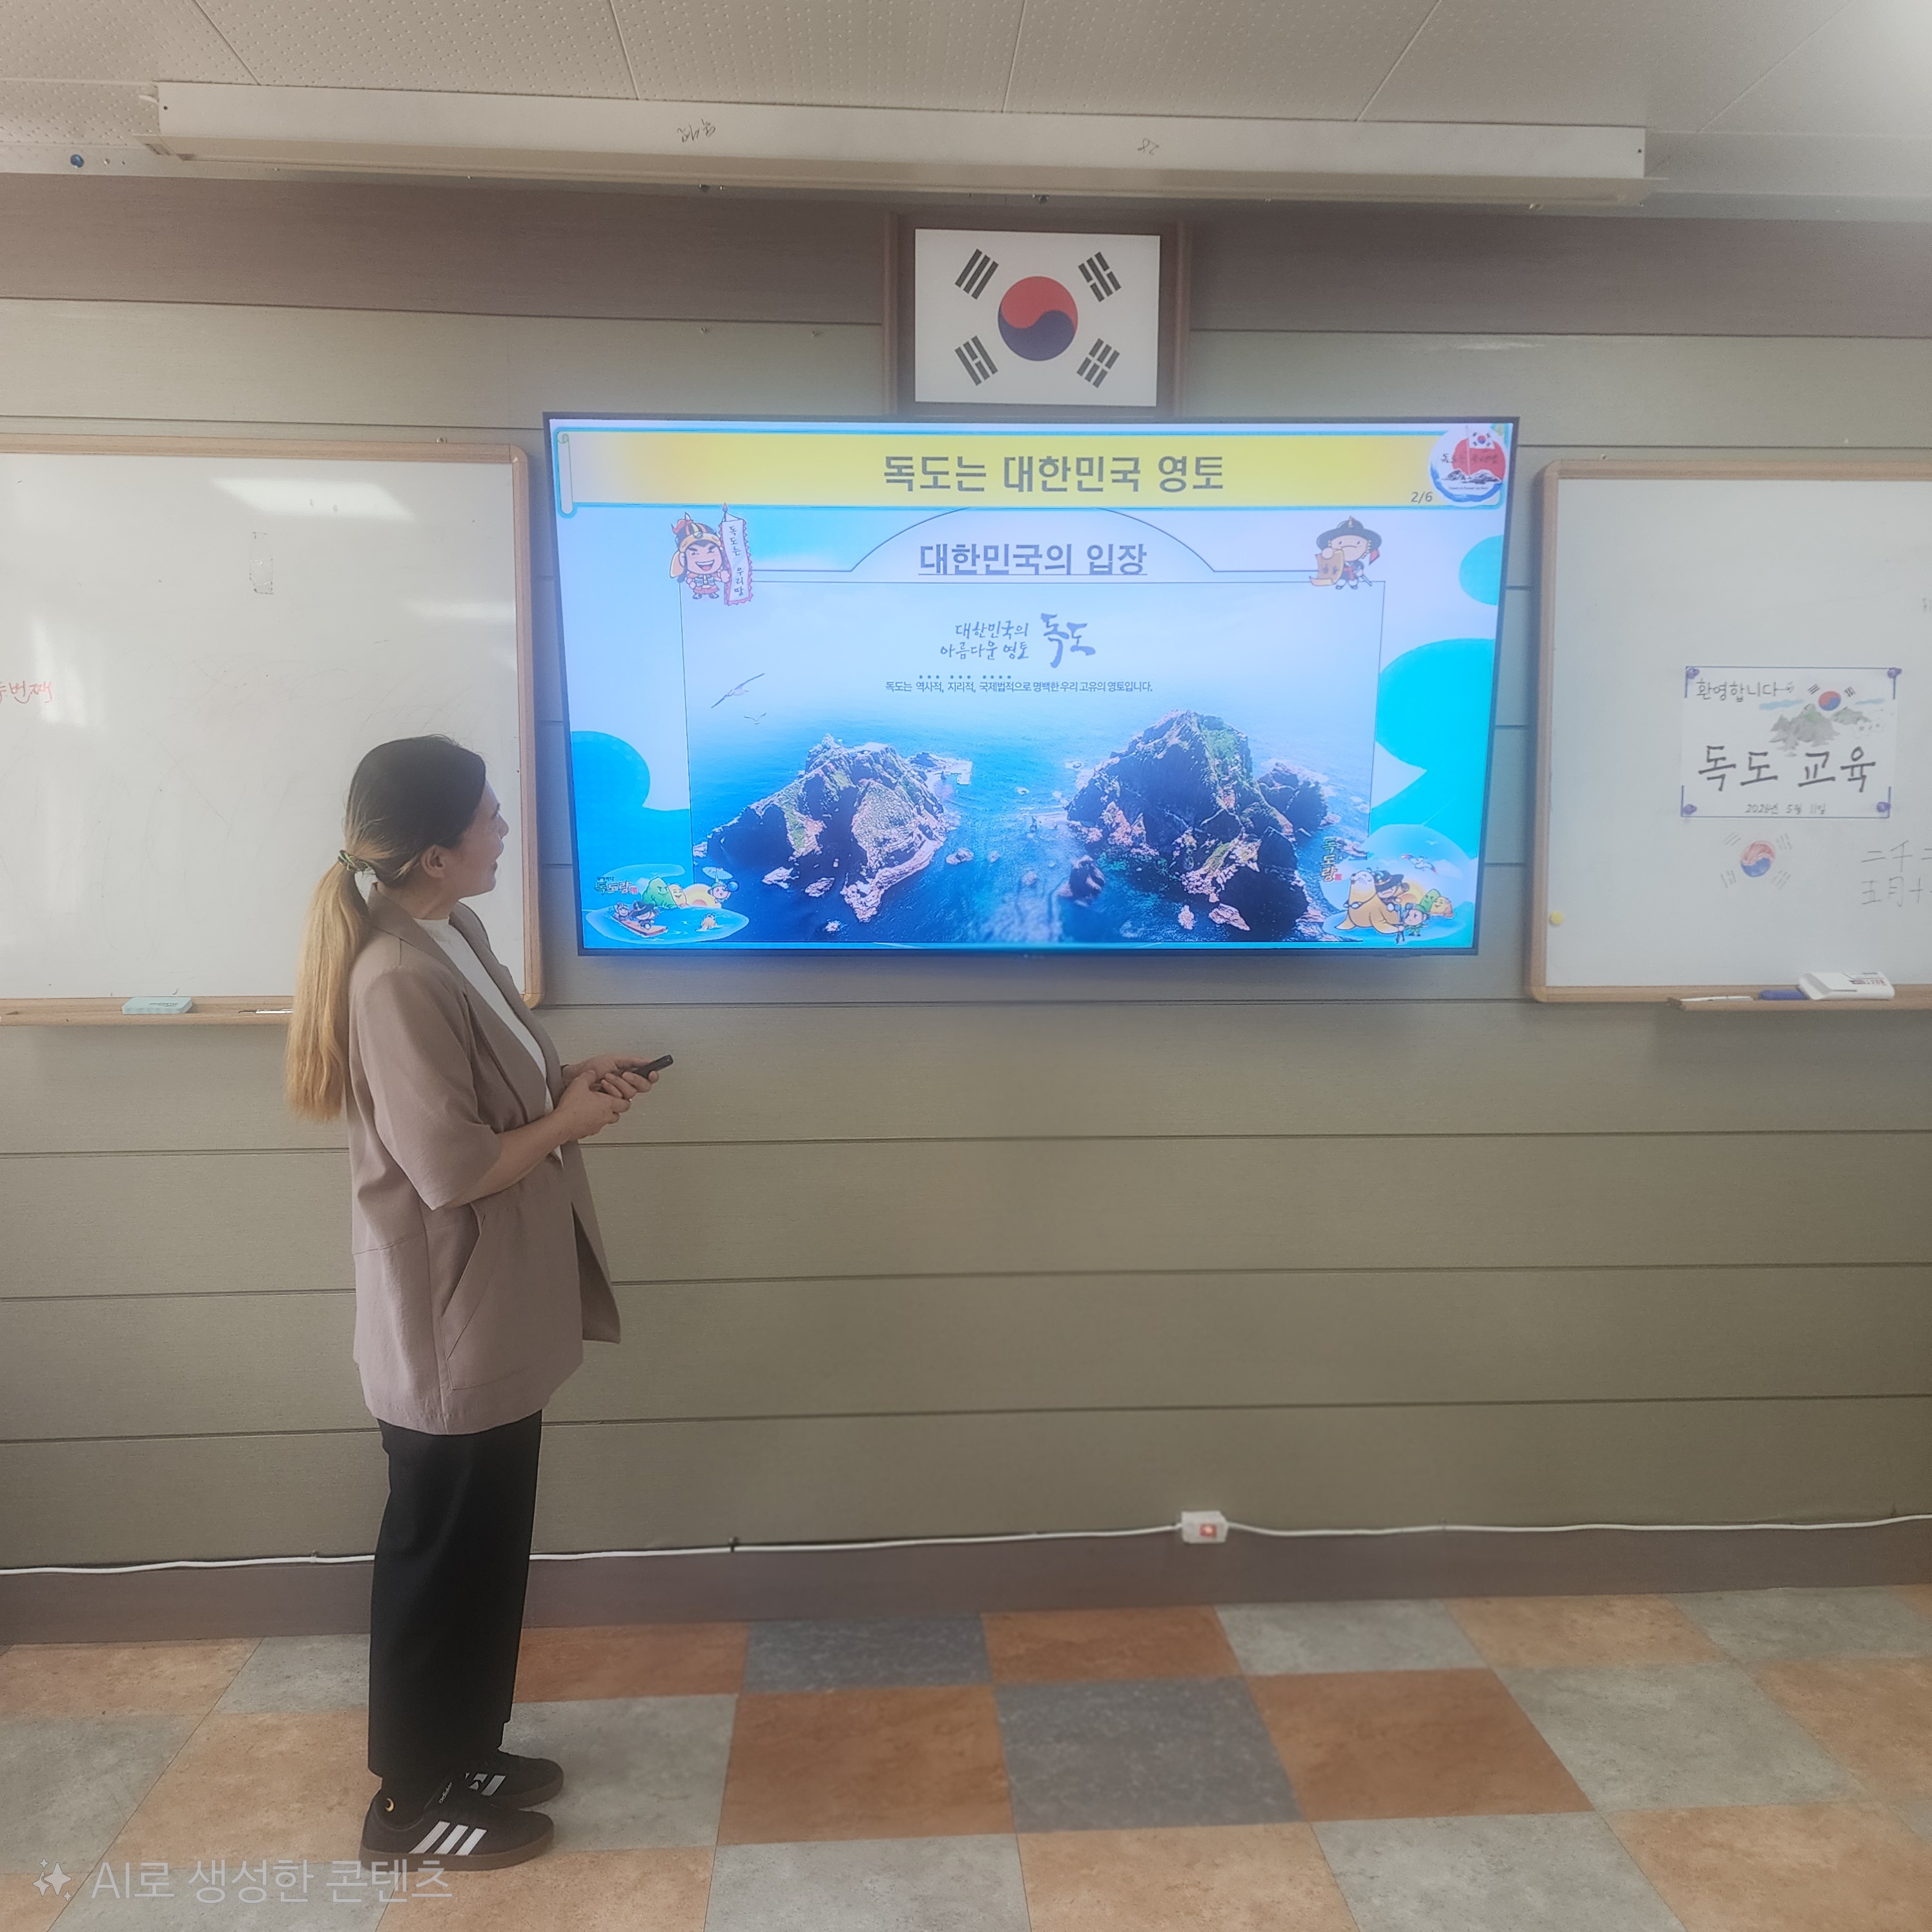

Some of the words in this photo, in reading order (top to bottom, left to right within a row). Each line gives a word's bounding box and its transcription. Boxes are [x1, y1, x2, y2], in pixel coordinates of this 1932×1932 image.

[883, 456, 987, 493] 독도는
[1003, 456, 1141, 493] 대한민국
[1158, 455, 1224, 493] 영토
[1410, 491, 1433, 504] 2/6
[728, 526, 741, 556] 독도는
[920, 543, 1072, 575] 대한민국의
[1086, 543, 1147, 575] 입장
[955, 620, 1029, 639] 대한민국의
[1040, 613, 1096, 668] 독도
[940, 640, 998, 660] 아름다운
[1003, 641, 1029, 660] 영토
[885, 681, 912, 692] 독도는
[916, 681, 944, 693] 역사적,
[947, 681, 976, 693] 지리적,
[979, 681, 1031, 692] 국제법적으로
[1033, 681, 1059, 692] 명백한
[1060, 681, 1078, 692] 우리
[1079, 681, 1106, 692] 고유의
[1107, 681, 1153, 692] 영토입니다.
[1696, 678, 1781, 703] 환영합니다
[1698, 745, 1778, 792] 독도
[1798, 746, 1876, 793] 교육
[1321, 836, 1338, 883] 독도랑
[594, 880, 632, 896] 독도랑
[1861, 876, 1932, 907] 五月十
